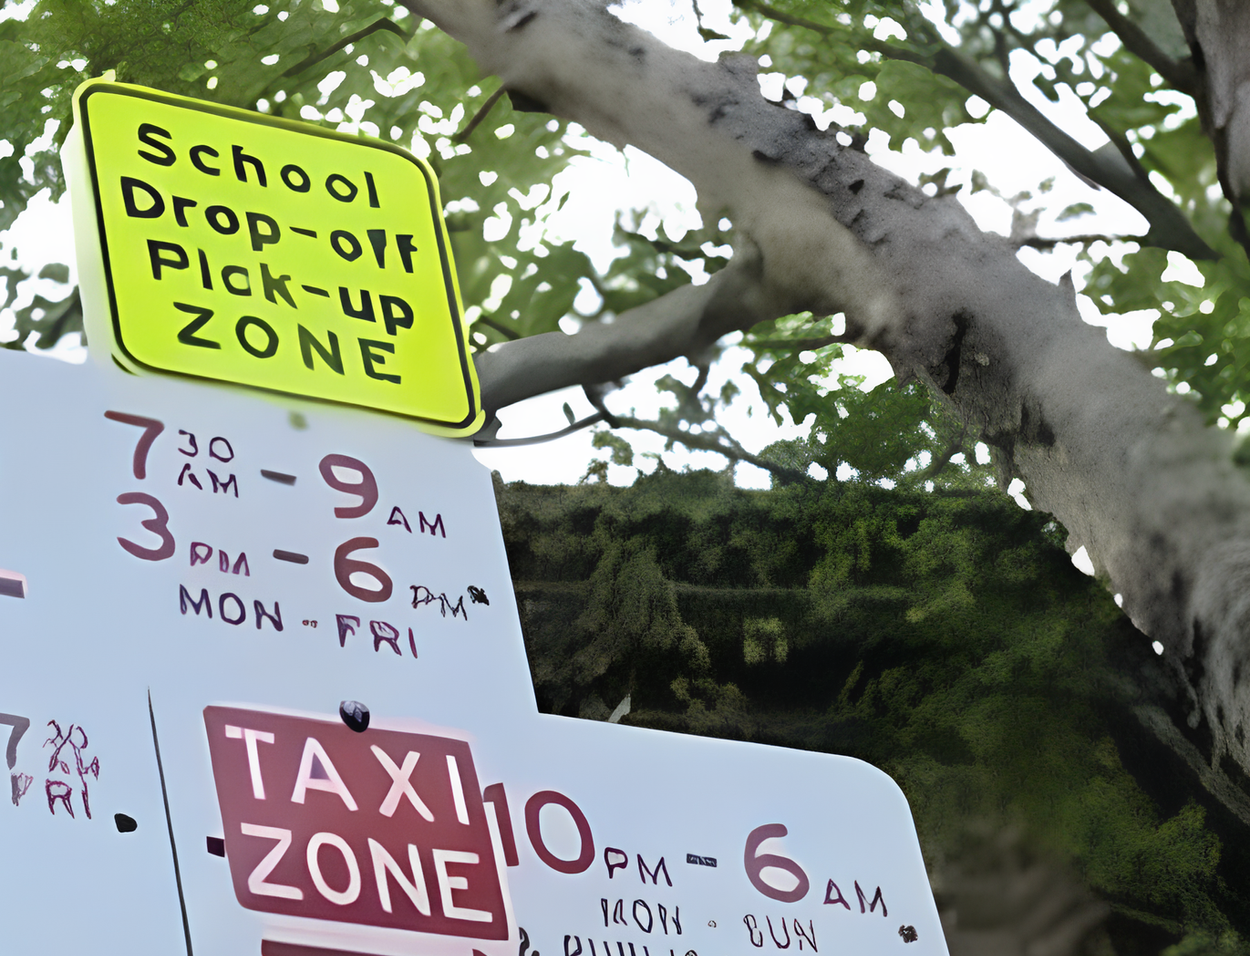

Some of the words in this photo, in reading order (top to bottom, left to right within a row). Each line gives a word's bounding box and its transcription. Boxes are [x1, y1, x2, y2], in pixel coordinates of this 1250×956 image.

[137, 123, 381, 208] School
[173, 301, 402, 385] ZONE
[178, 584, 284, 632] MON
[335, 613, 418, 659] FRI
[225, 724, 469, 825] TAXI
[240, 822, 493, 923] ZONE
